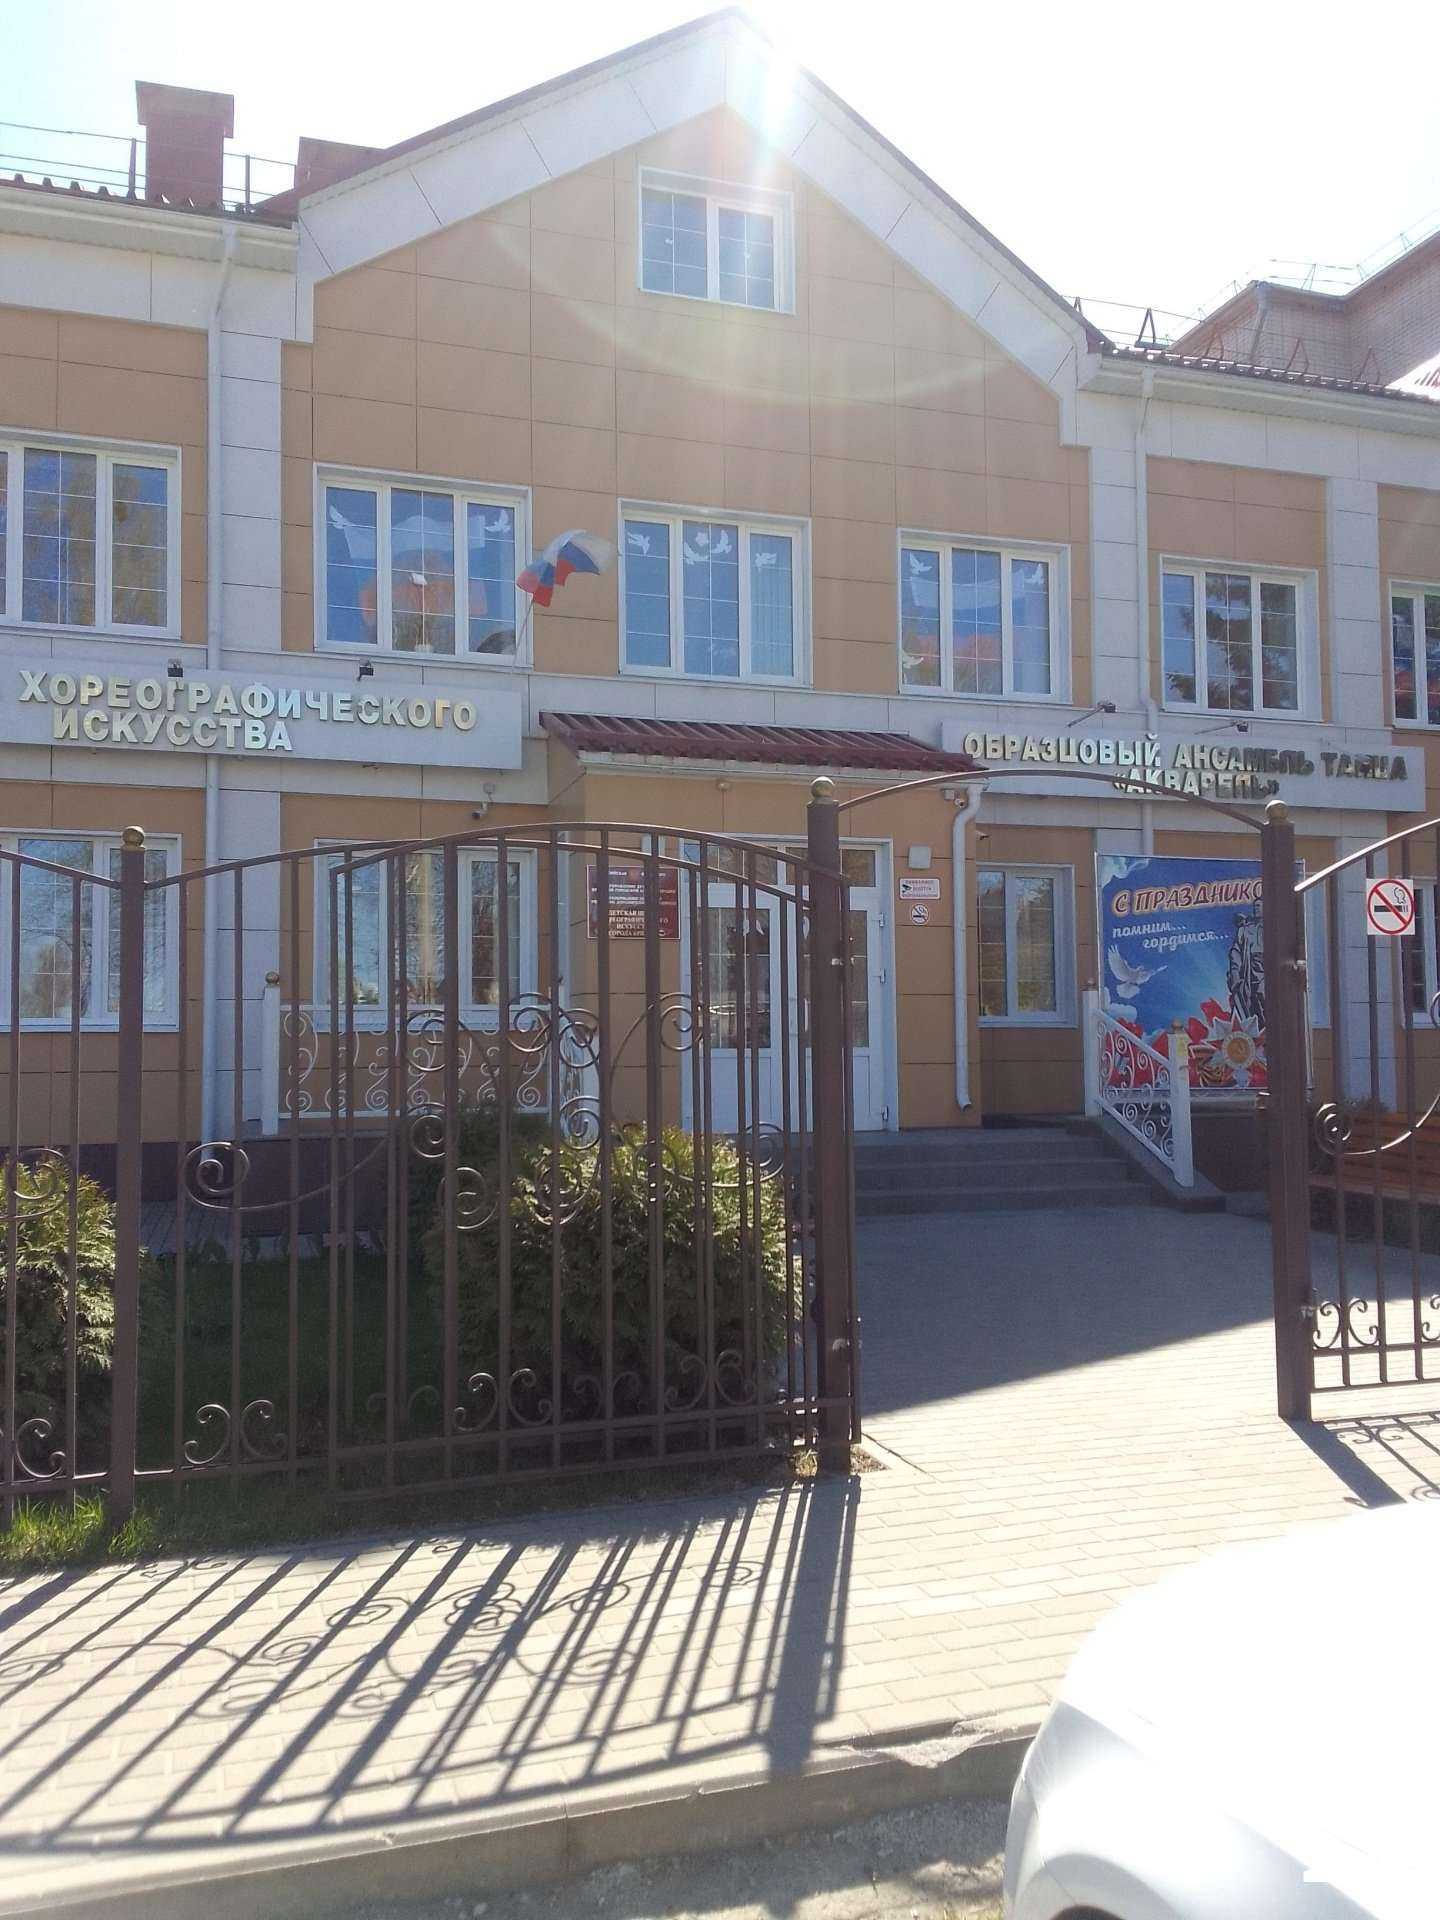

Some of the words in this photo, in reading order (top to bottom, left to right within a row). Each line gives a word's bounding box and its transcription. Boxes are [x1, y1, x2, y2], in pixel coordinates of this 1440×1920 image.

[18, 670, 478, 730] ХОРЕОГРАФИЧЕСКОГО
[53, 708, 293, 751] ИСКУССТВА
[964, 731, 1161, 768] ОБРАЗЦОВЫЙ
[1173, 743, 1314, 776] АНСАМБЛЬ
[1321, 751, 1408, 781] ТАНЦА
[1113, 892, 1129, 914] С
[1134, 878, 1264, 912] ПРАЗДНИКО
[1112, 920, 1187, 938] помним...
[1143, 930, 1230, 952] гордимся...
